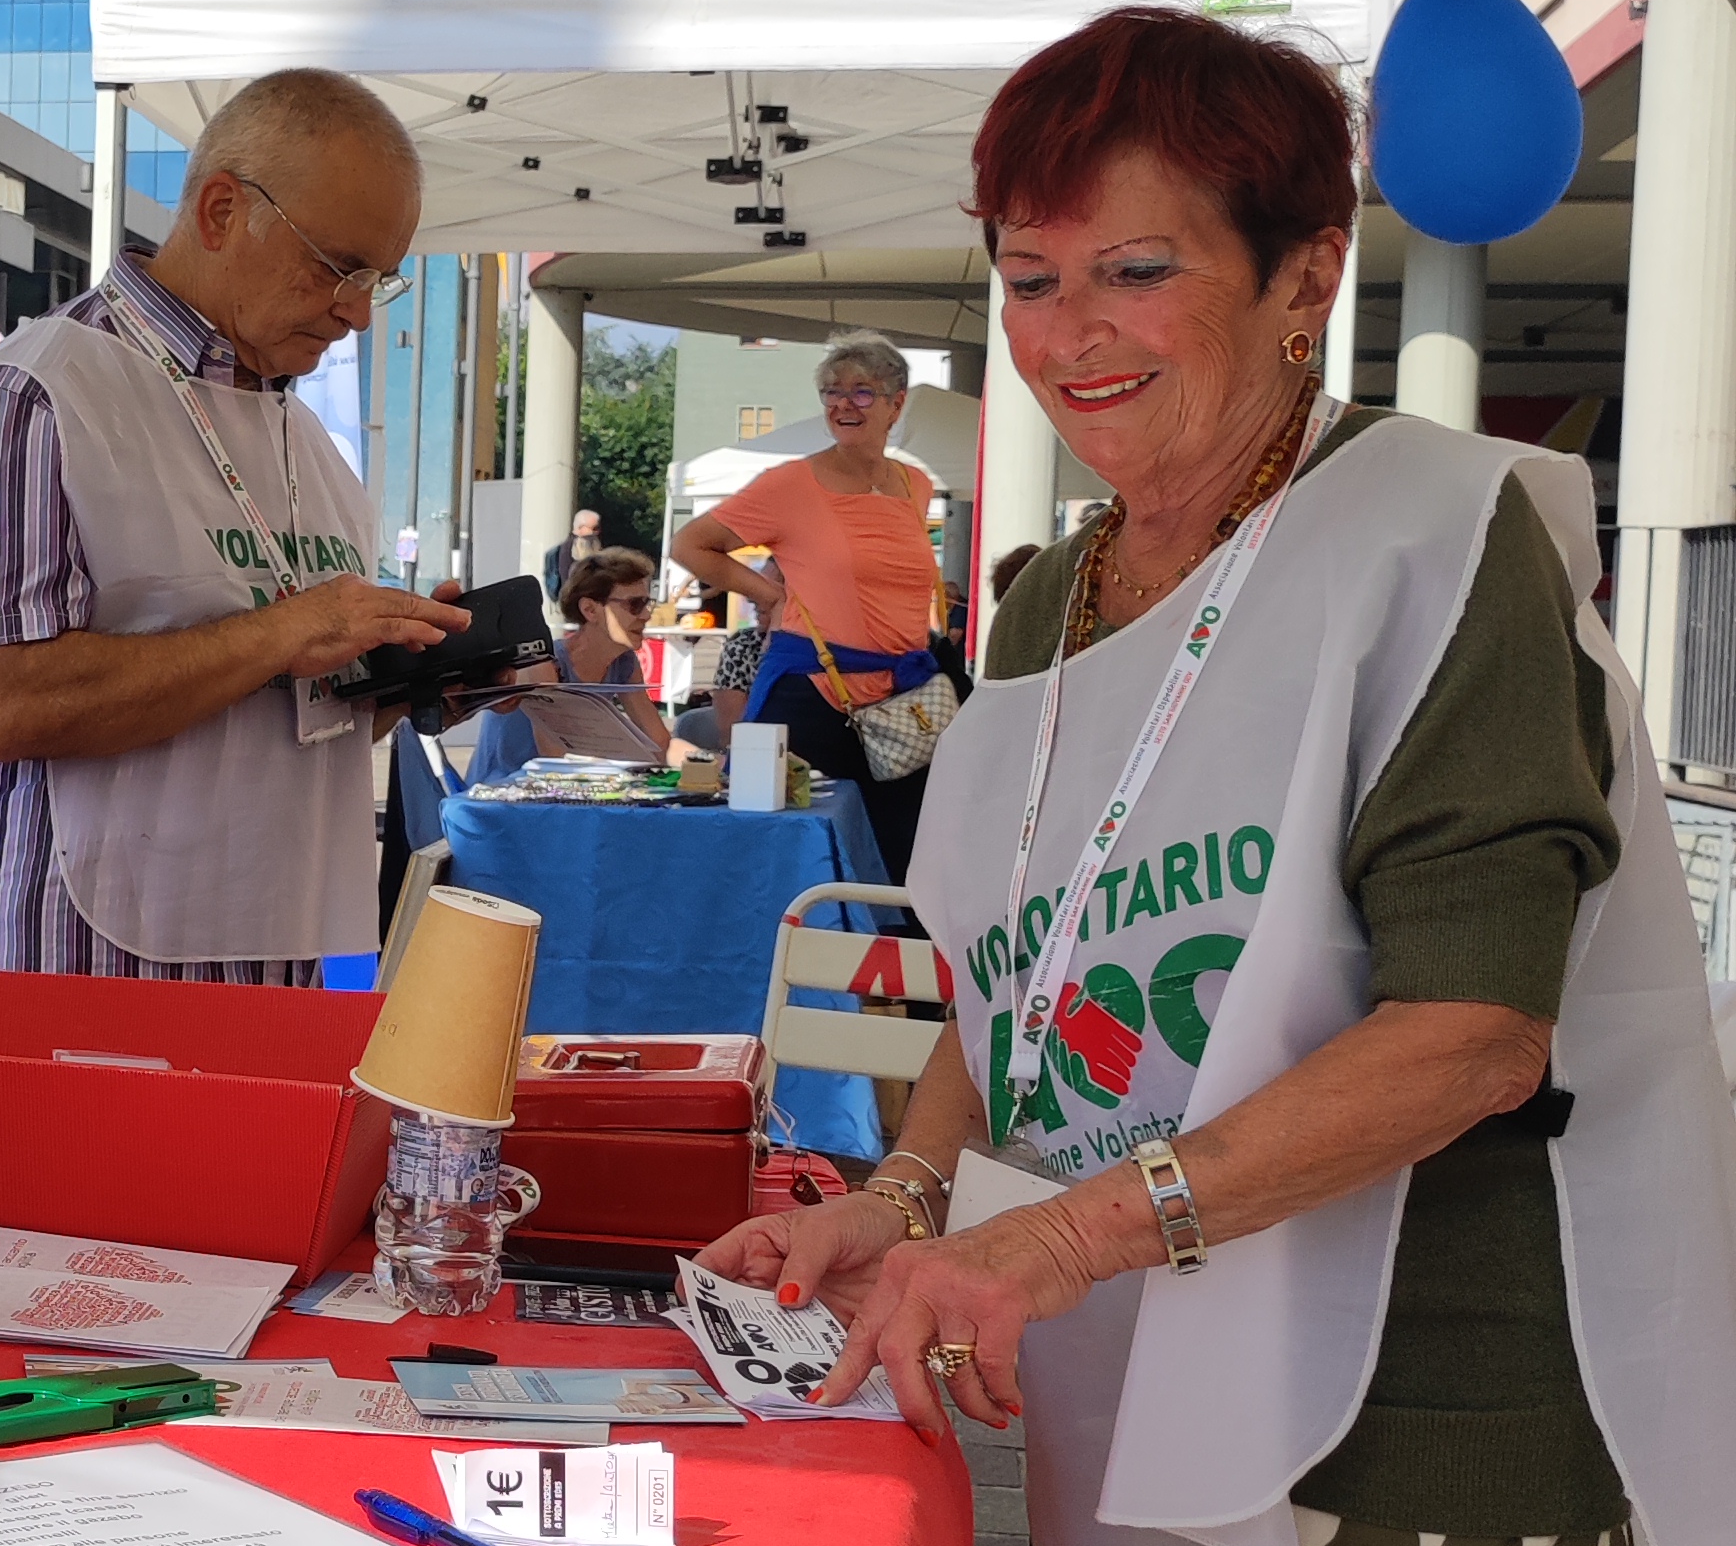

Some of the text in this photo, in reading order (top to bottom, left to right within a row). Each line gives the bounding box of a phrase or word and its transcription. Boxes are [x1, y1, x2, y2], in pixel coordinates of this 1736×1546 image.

[1140, 711, 1163, 746] Volontari
[1157, 669, 1183, 711] Ospedalieri
[1051, 901, 1071, 940] Volontari
[1065, 860, 1089, 904] Ospedalieri
[3, 1500, 58, 1514] inizio
[74, 1494, 113, 1504] fine
[115, 1487, 189, 1500] servizio
[4, 1492, 49, 1504] gilet
[485, 1469, 524, 1517] 1€
[651, 1476, 665, 1506] 0201
[64, 1502, 137, 1516] (cassa)
[73, 1512, 144, 1526] gazebo
[110, 1529, 191, 1546] persone
